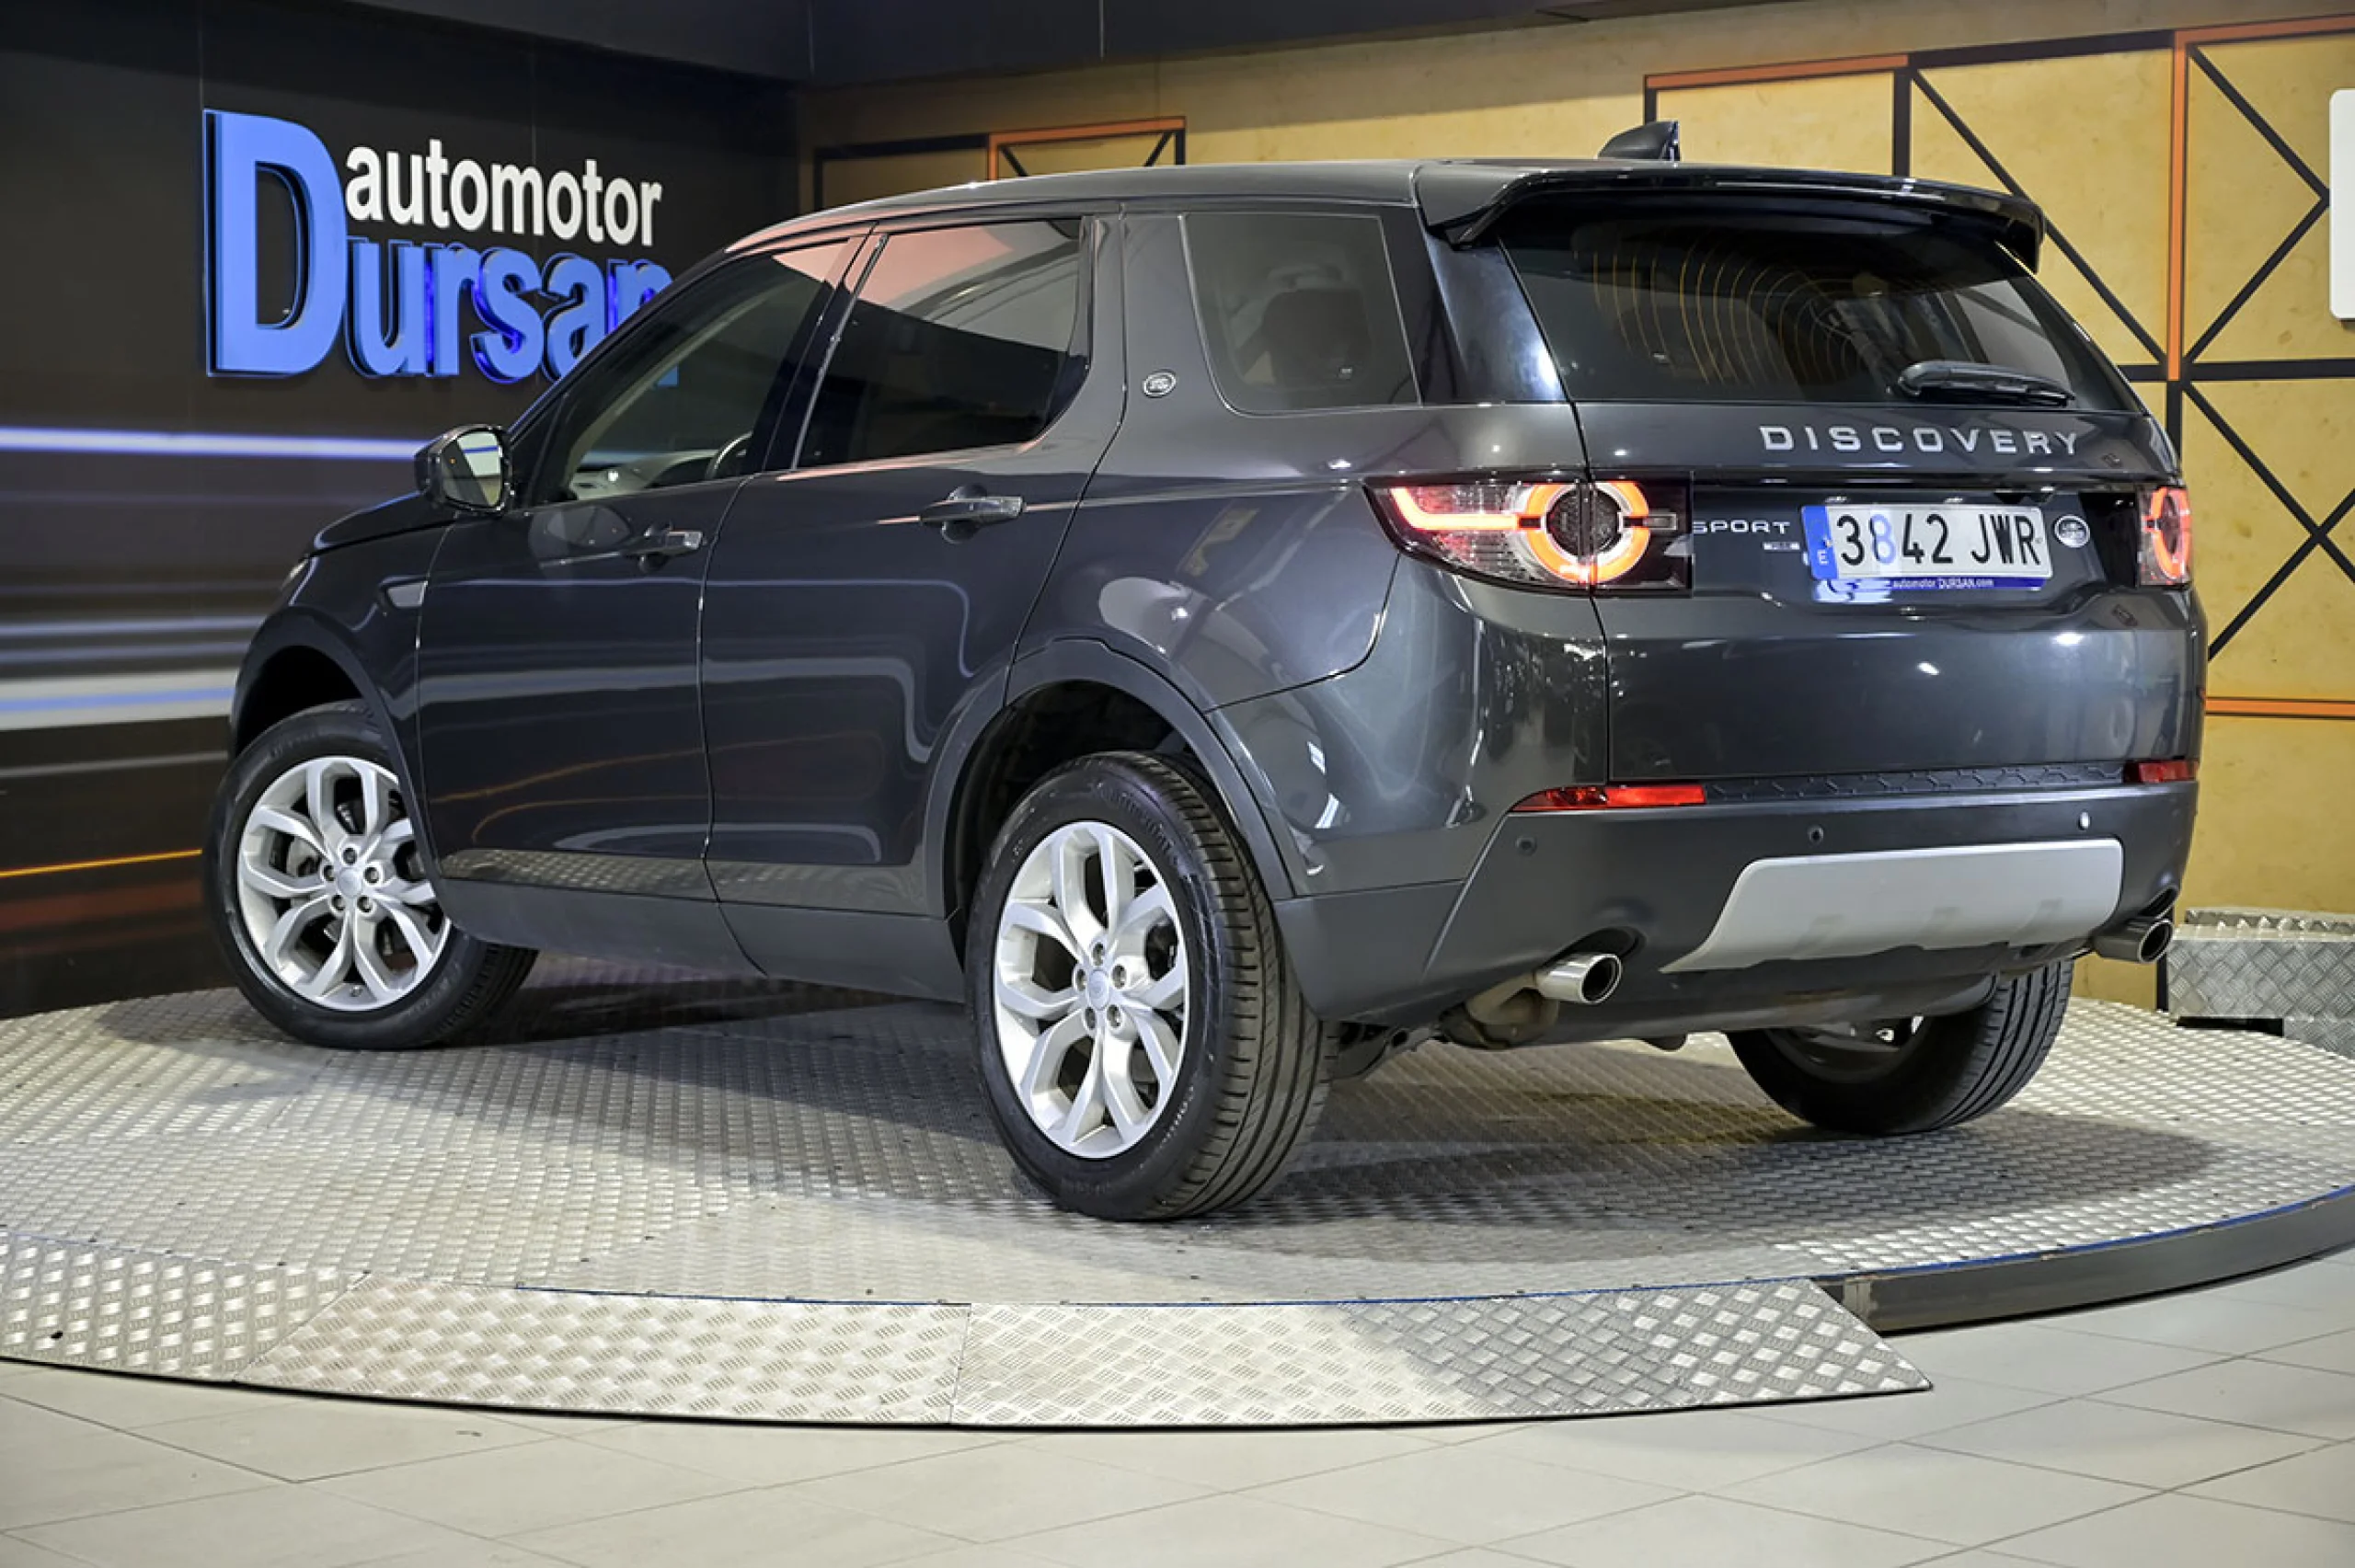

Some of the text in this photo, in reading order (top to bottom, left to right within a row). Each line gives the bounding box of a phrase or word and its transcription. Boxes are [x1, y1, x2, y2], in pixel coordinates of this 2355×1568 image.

[345, 139, 662, 246] automotor
[1759, 425, 2077, 454] DISCOVERY
[1693, 519, 1790, 535] SPORT
[1836, 513, 2041, 567] 3842 JWR
